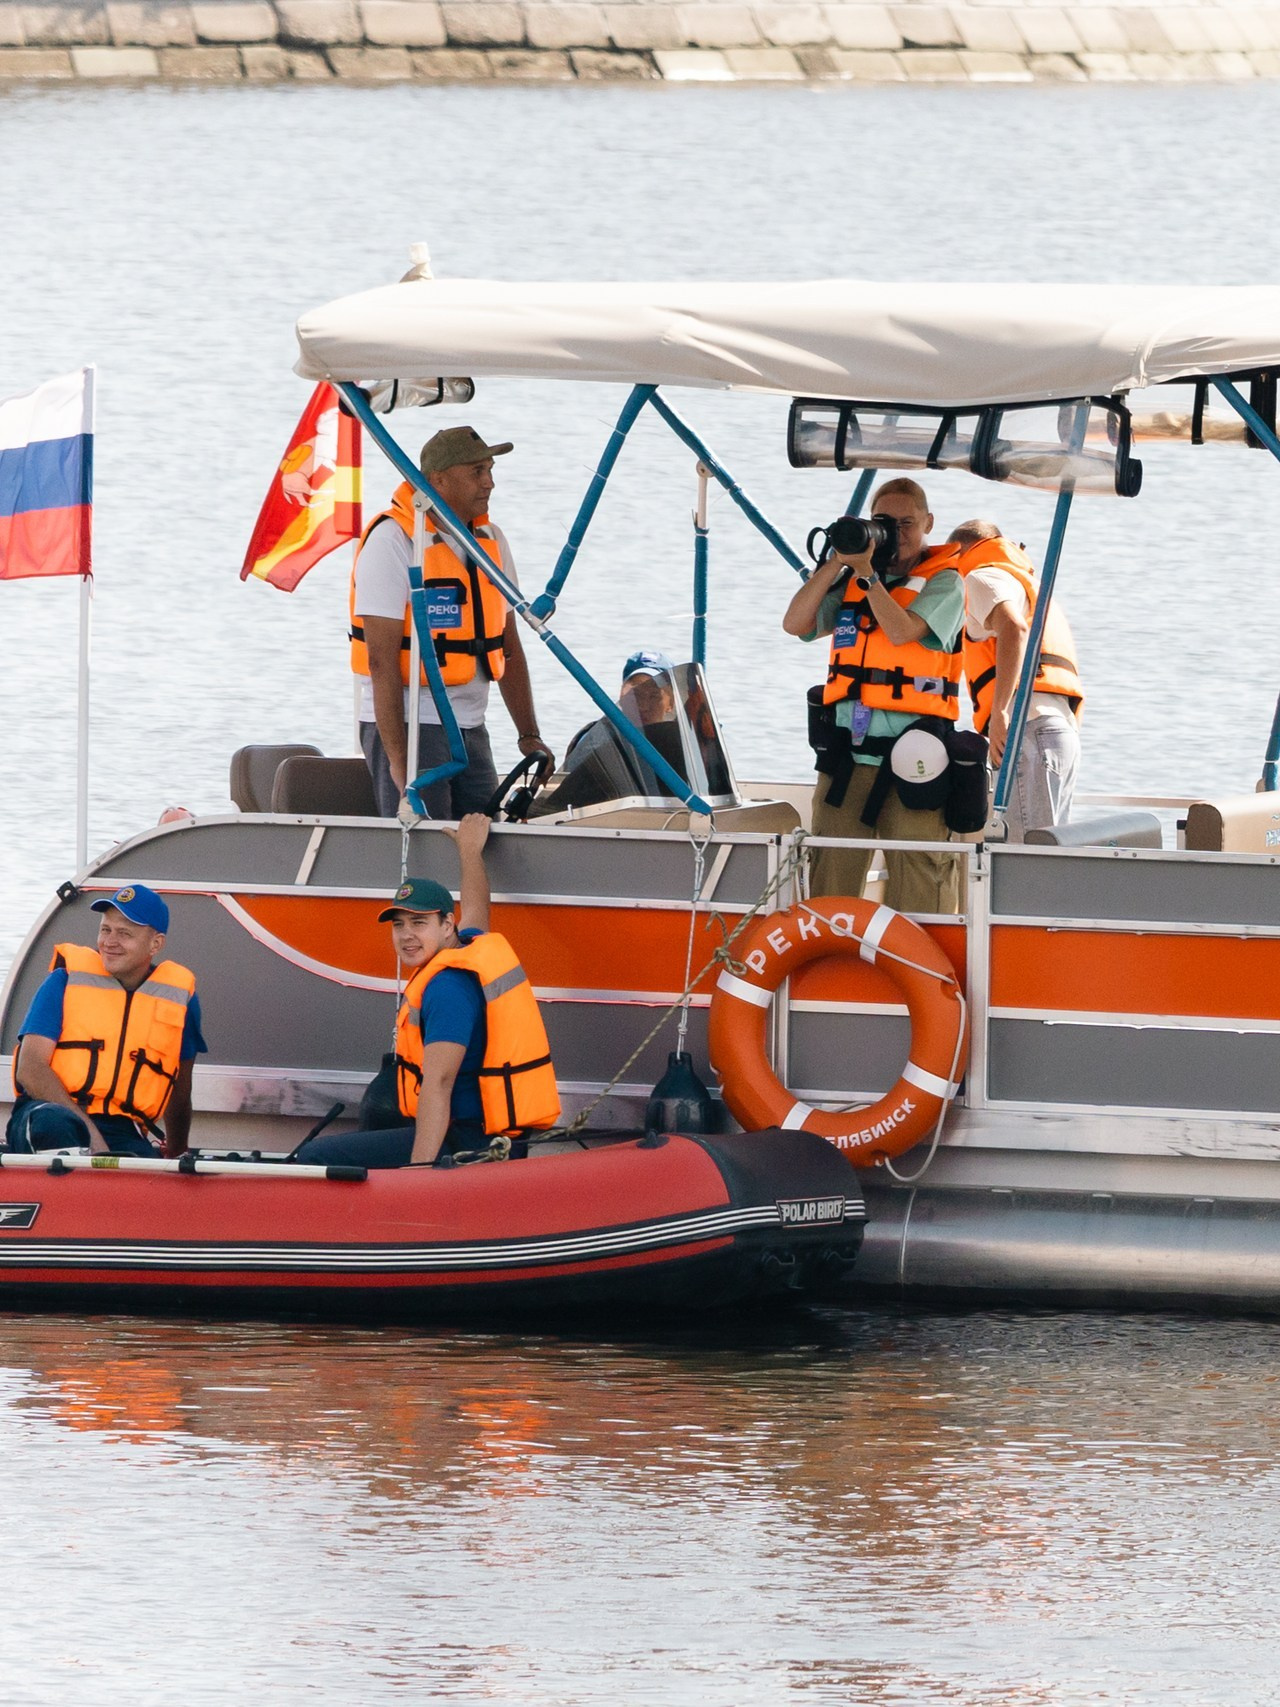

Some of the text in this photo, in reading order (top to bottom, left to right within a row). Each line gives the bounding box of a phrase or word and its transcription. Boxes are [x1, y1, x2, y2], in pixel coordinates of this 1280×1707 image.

[822, 1098, 916, 1150] ЕЛЯБИНСК
[780, 1200, 842, 1222] POLAR BIRD
